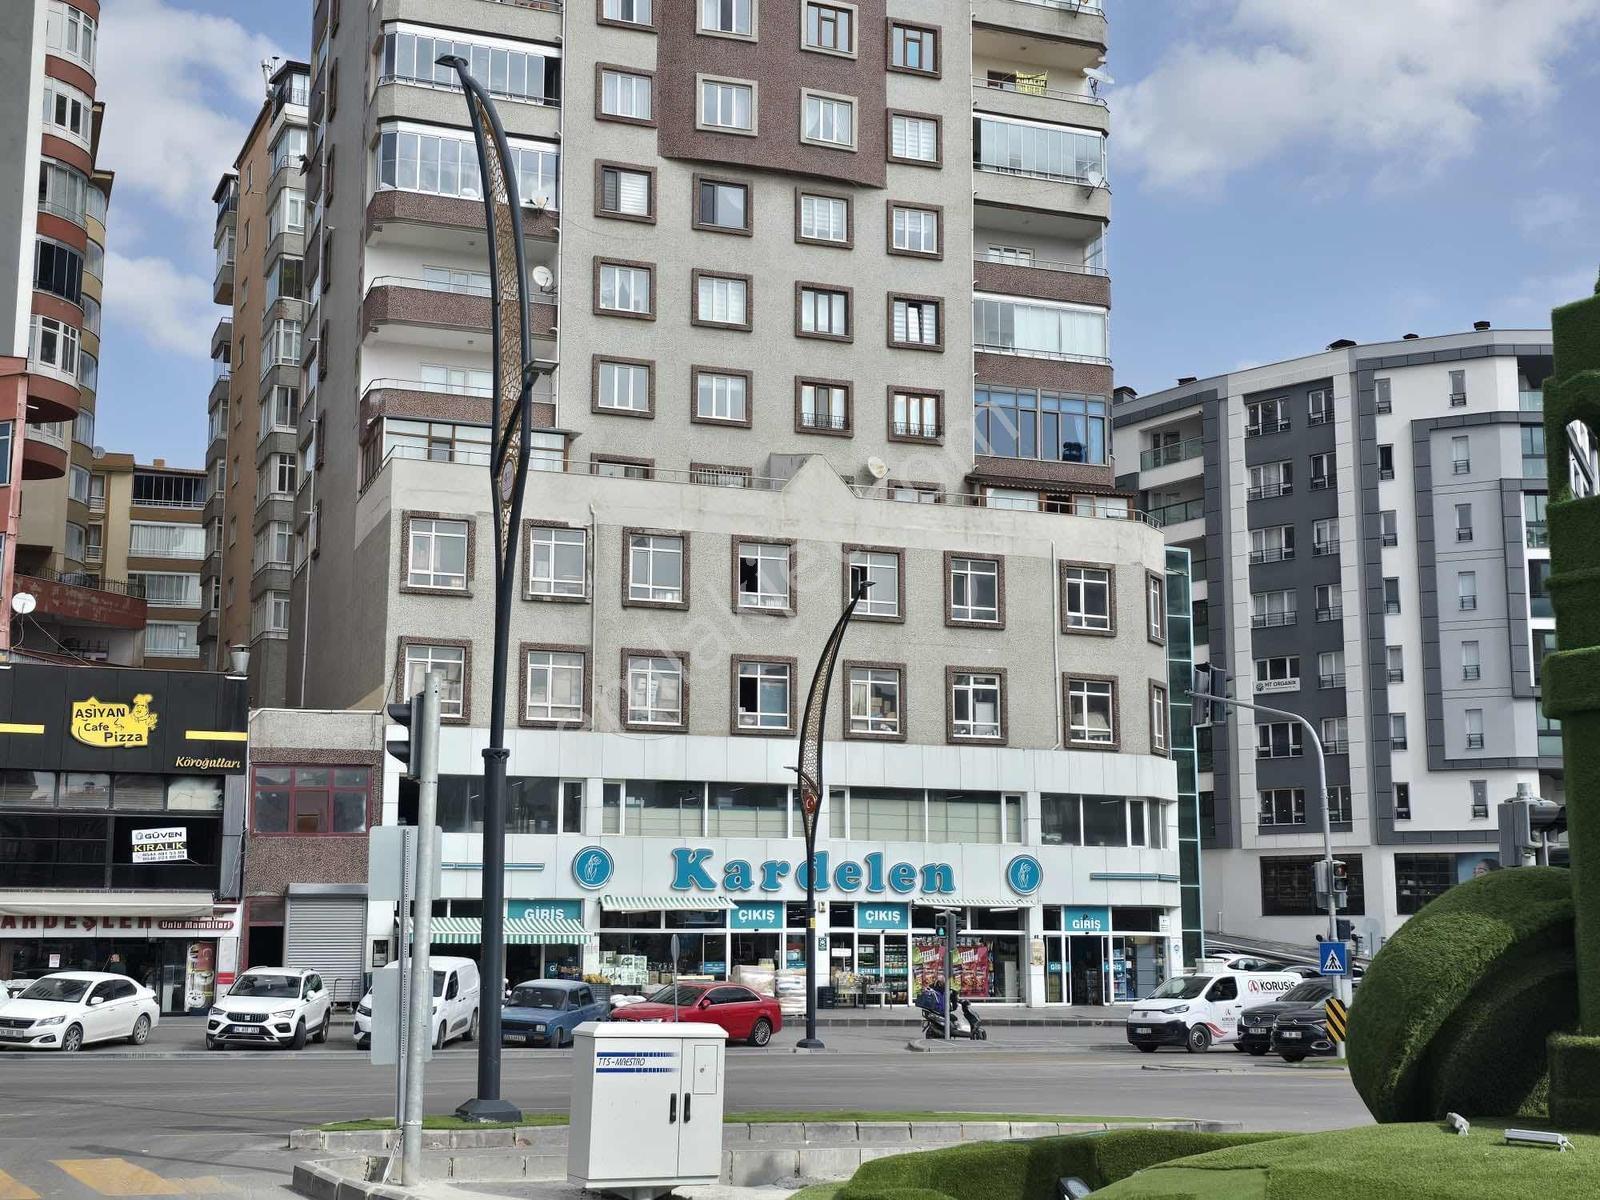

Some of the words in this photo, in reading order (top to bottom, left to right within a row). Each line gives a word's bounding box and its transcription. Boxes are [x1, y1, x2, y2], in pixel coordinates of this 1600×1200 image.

[84, 722, 110, 732] Cafe
[104, 732, 143, 743] Pizza
[175, 756, 241, 770] Köroğulları
[144, 831, 183, 840] GÜVEN
[671, 848, 957, 894] Kardelen
[738, 909, 776, 923] ÇIKIŞ
[865, 910, 901, 924] ÇIKIŞ
